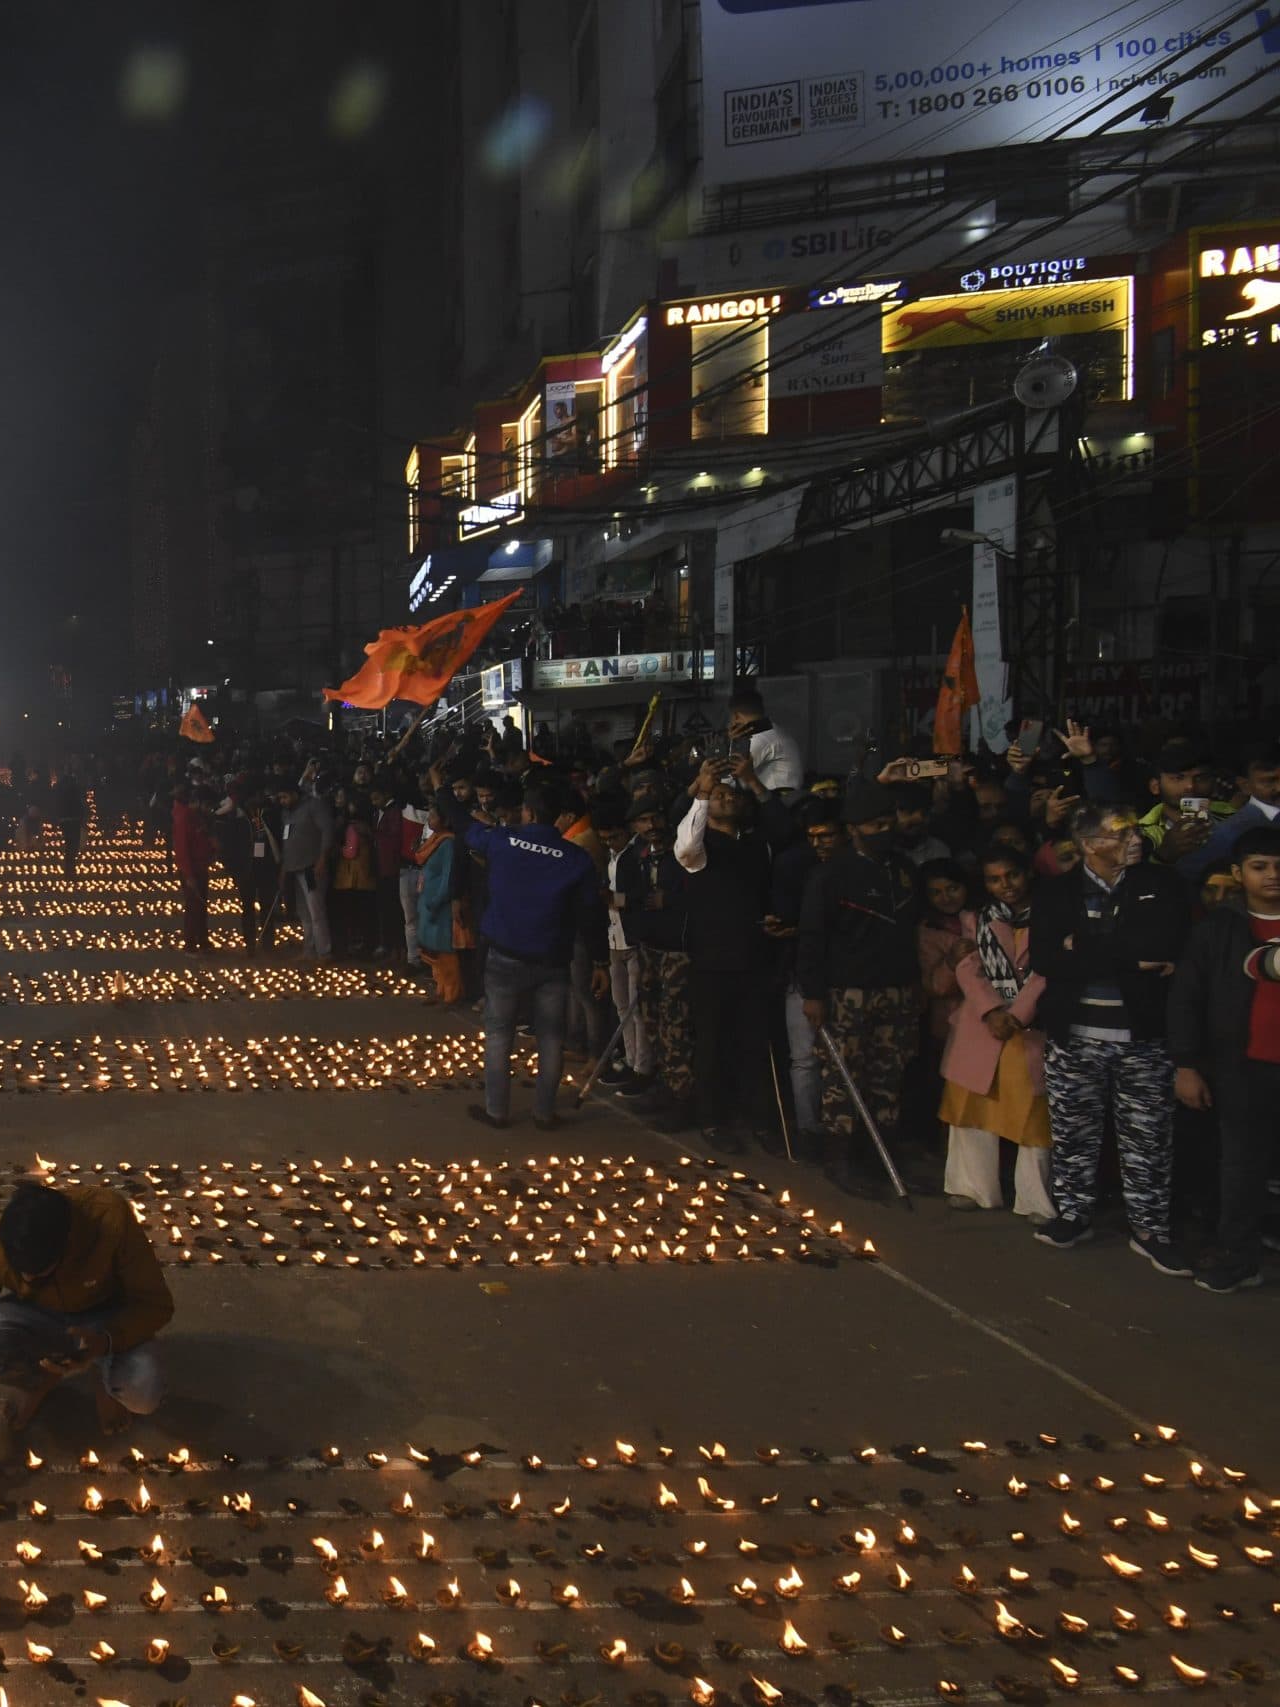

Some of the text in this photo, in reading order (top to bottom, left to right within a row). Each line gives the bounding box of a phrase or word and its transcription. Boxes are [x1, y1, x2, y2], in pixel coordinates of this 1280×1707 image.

[874, 61, 992, 93] 5,00,000+
[1001, 49, 1081, 74] homes
[1116, 38, 1157, 59] 100
[1165, 30, 1231, 54] cities
[808, 78, 858, 97] INDIA'S
[877, 99, 900, 120] T:
[909, 91, 965, 116] 1800
[973, 84, 1019, 107] 266
[1027, 76, 1085, 99] 0106
[731, 88, 794, 113] INDIA'S
[809, 93, 857, 109] LARGEST
[732, 105, 794, 125] FAVOURITE
[809, 103, 859, 121] SELLING
[732, 119, 789, 140] GERMAN
[791, 226, 894, 259] SBI Life
[990, 257, 1086, 279] BOUTIQUE
[666, 295, 782, 326] RANGOLI
[996, 299, 1115, 322] SHIV-NARESH
[565, 654, 685, 679] RANGOLI
[508, 837, 565, 858] VOLVO
